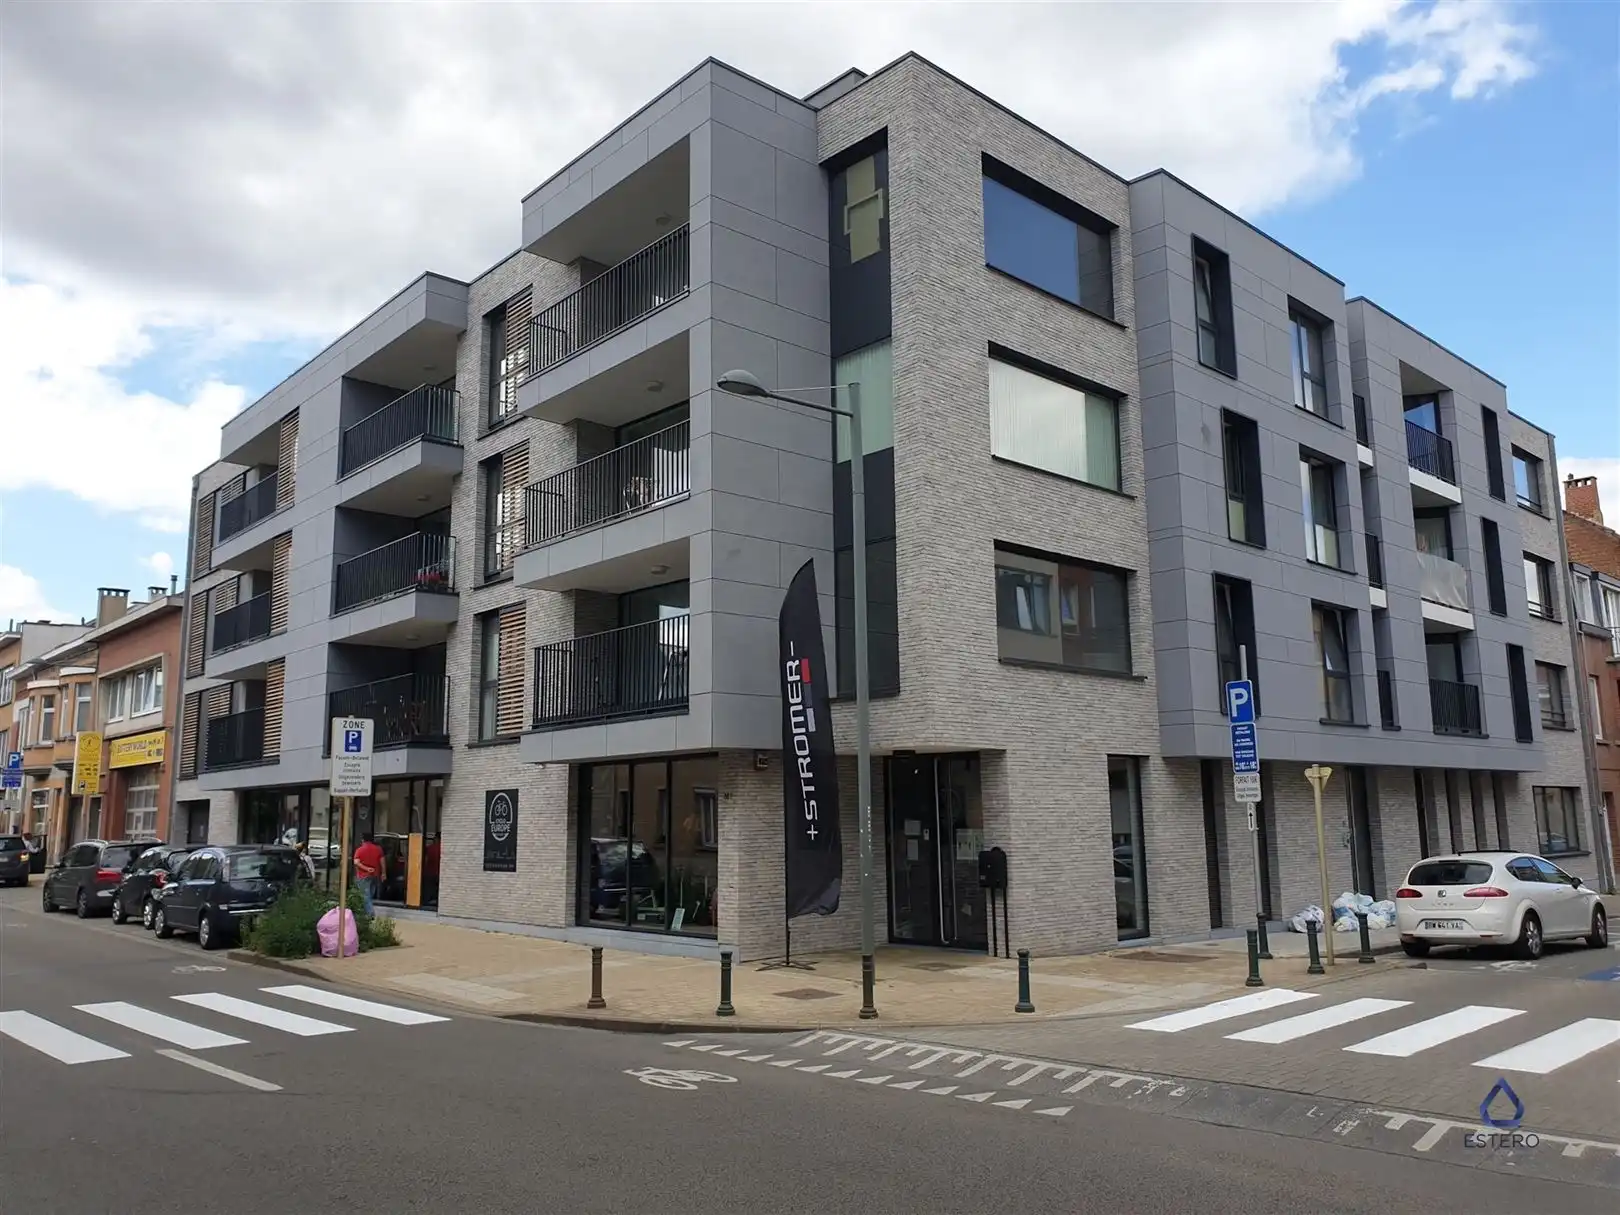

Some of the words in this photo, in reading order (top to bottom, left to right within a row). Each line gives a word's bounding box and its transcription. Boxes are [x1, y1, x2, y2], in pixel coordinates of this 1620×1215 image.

[1230, 688, 1248, 717] P
[343, 720, 366, 729] ZONE
[348, 731, 358, 744] P
[8, 754, 19, 767] P
[491, 823, 511, 833] EUROPE
